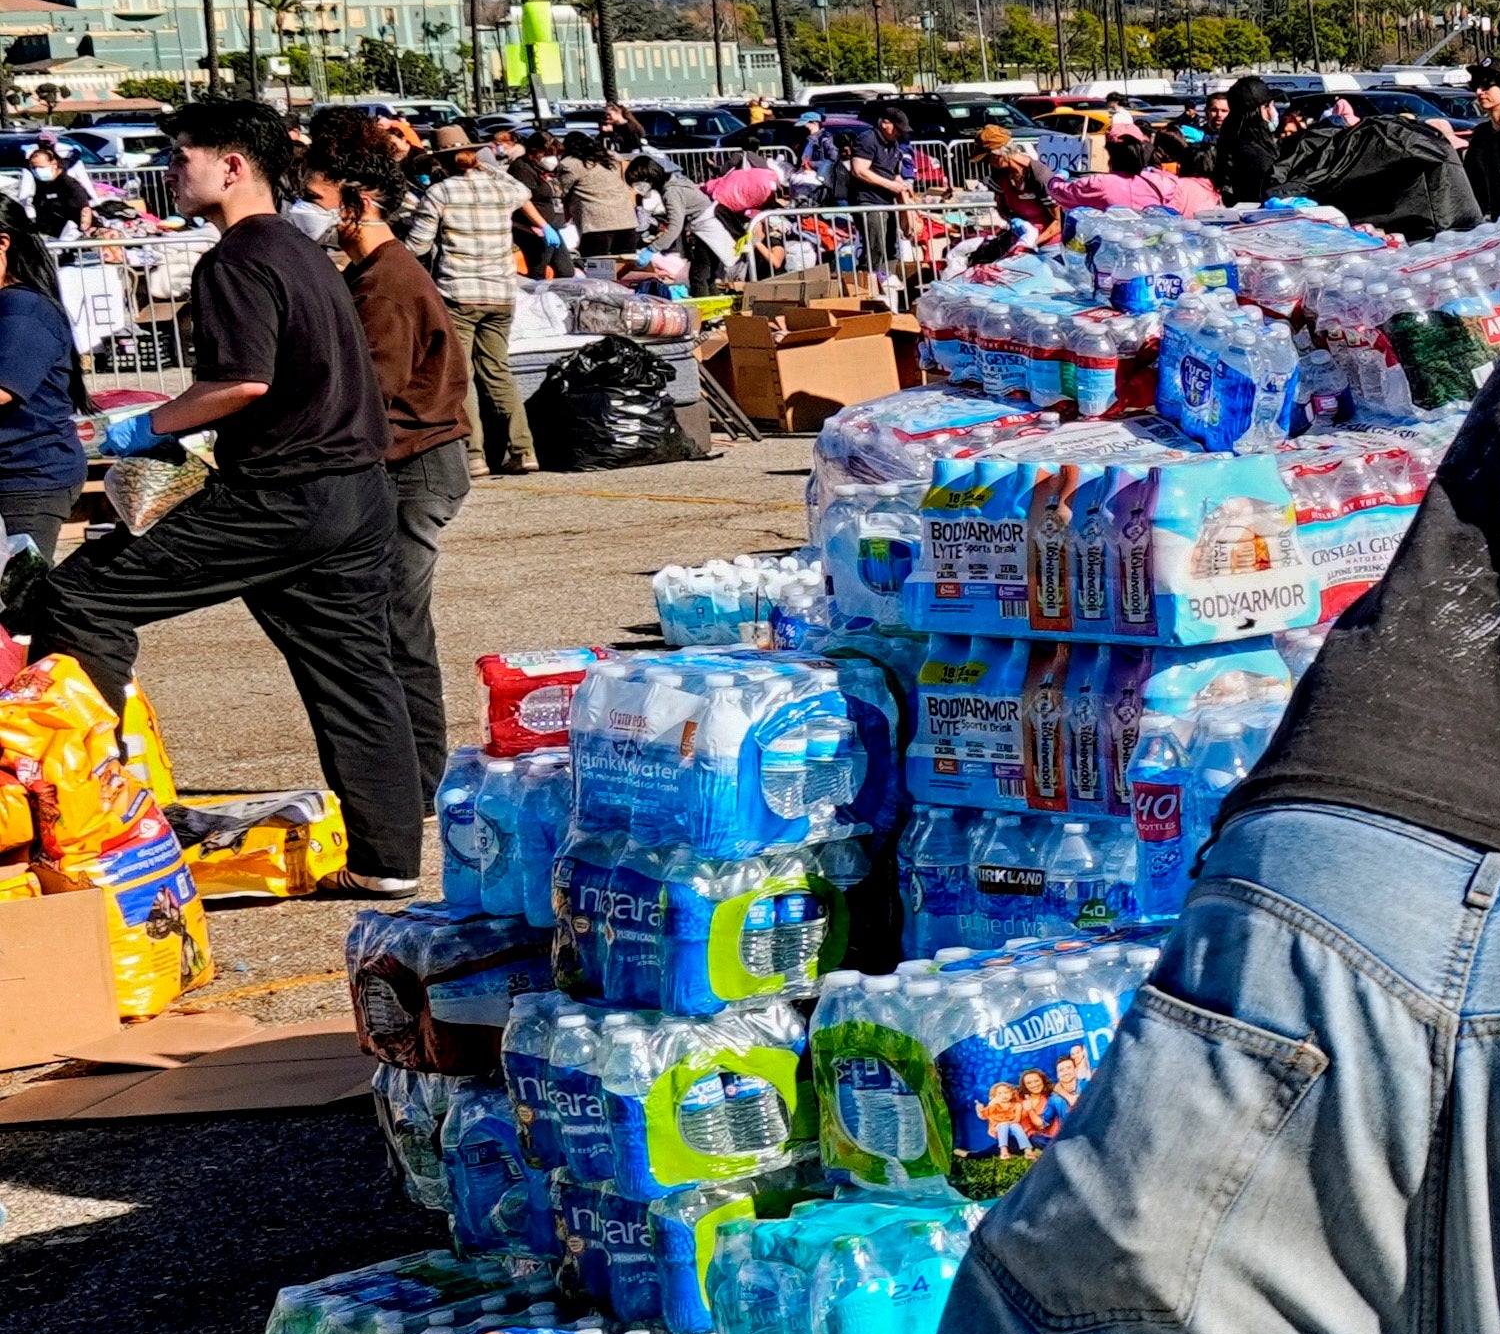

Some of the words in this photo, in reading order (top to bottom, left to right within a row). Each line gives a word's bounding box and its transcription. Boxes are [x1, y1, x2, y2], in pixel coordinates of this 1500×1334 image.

[1157, 276, 1181, 288] Pure
[1184, 356, 1211, 382] Pure
[1184, 372, 1205, 393] Life
[948, 492, 960, 503] 18
[930, 520, 1024, 543] BODYARMOR
[932, 541, 963, 559] LYTE
[964, 542, 991, 554] Sports
[1311, 545, 1366, 565] CRYSTAL
[1369, 534, 1401, 554] GEYS
[1346, 554, 1389, 564] NATURAL
[1352, 564, 1386, 574] SPRING
[1191, 583, 1305, 620] BODYARMOR
[942, 667, 955, 678] 18
[927, 696, 1019, 721] BODYARMOR
[930, 719, 961, 737] LYTE
[961, 720, 988, 731] Sports
[1136, 792, 1178, 820] 40
[1139, 821, 1176, 832] BOTTLES
[1081, 904, 1106, 917] 40
[507, 973, 529, 991] 35
[893, 1276, 931, 1299] 24
